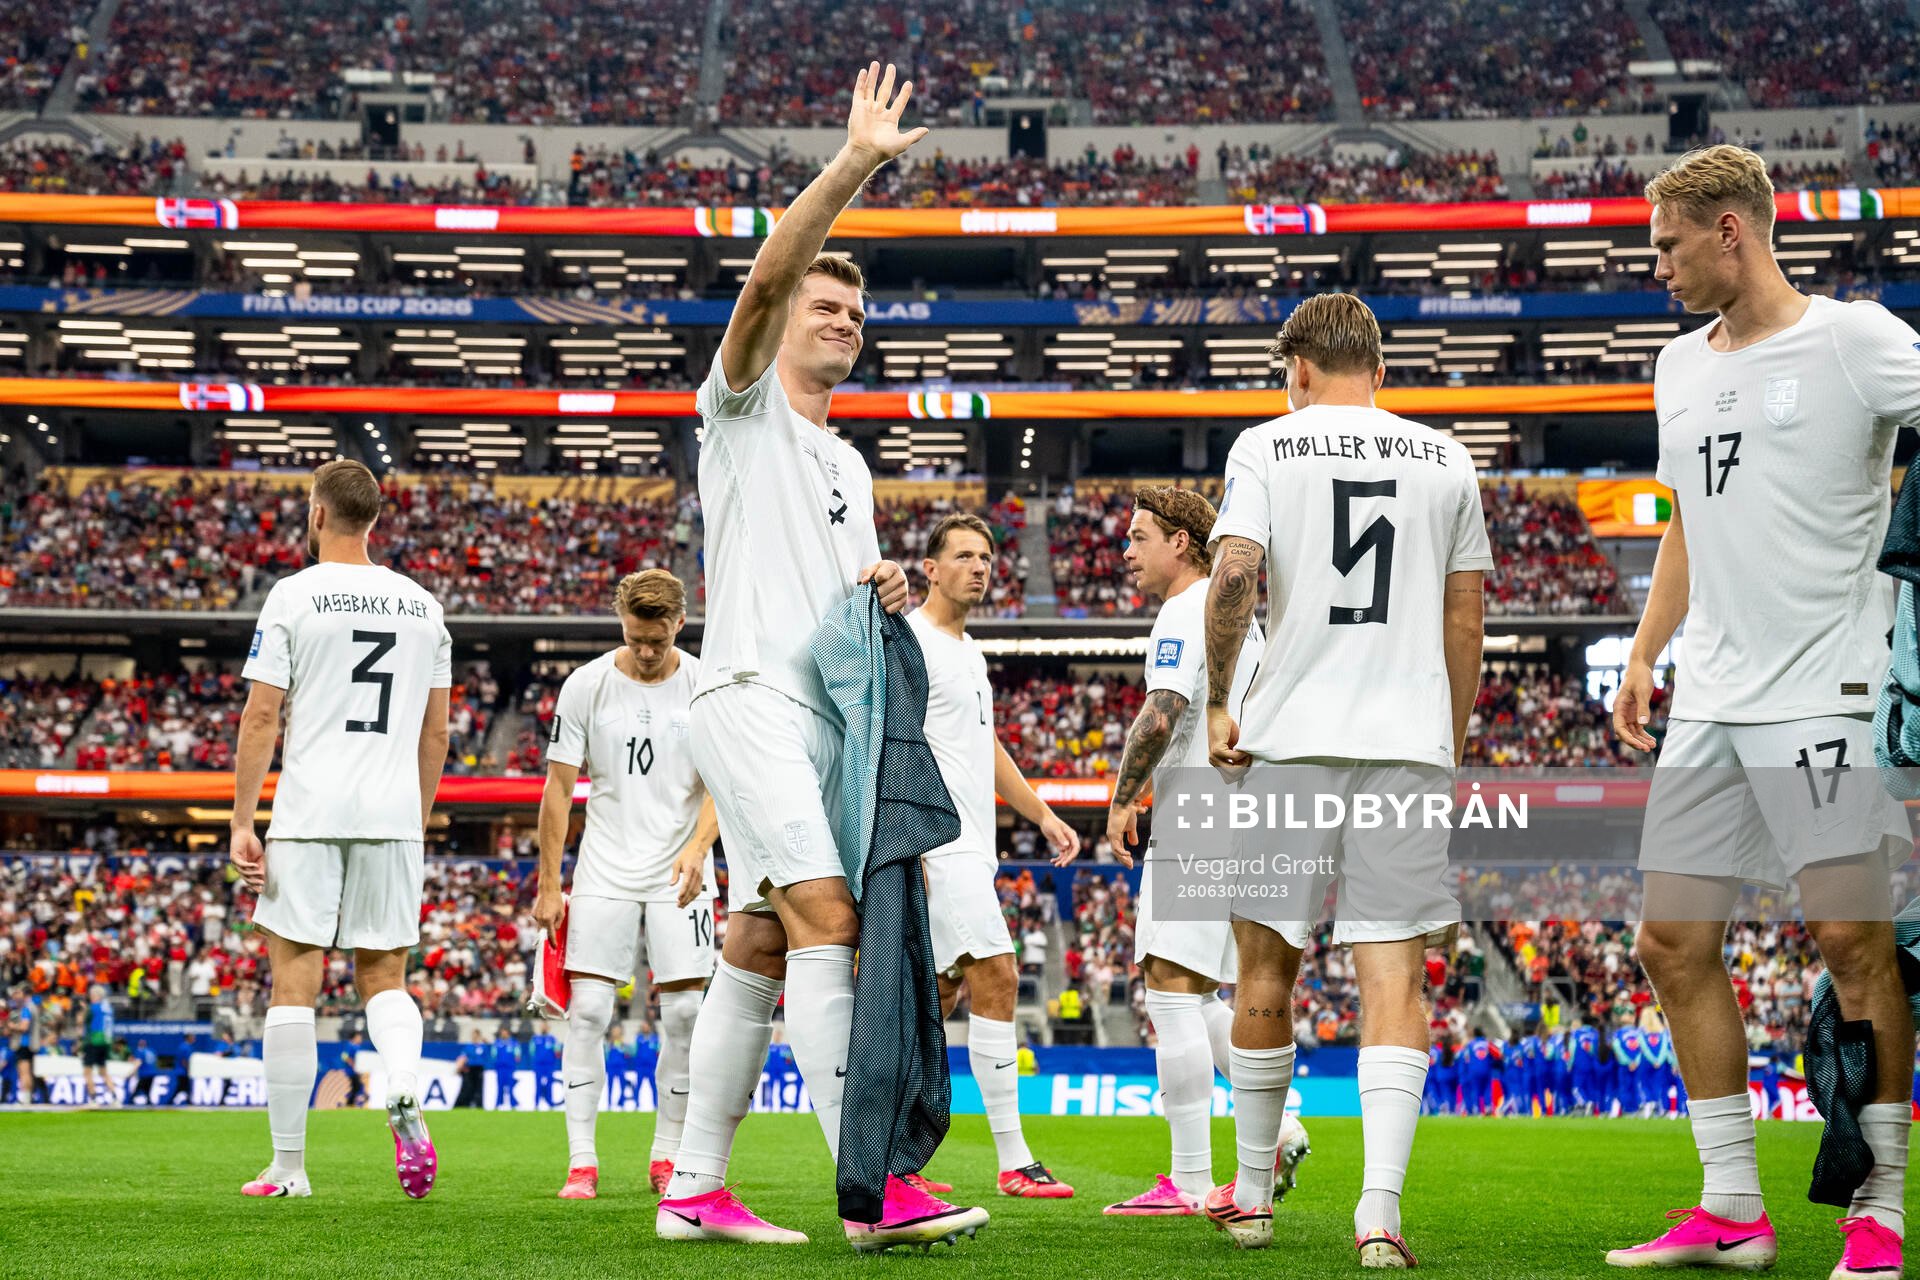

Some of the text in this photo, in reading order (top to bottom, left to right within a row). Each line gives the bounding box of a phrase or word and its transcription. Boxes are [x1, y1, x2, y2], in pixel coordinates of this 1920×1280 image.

[242, 295, 474, 316] FIFA WORLD CUP 2026
[865, 302, 931, 320] LAS
[1273, 435, 1448, 467] MØLLER WOLFE
[1698, 431, 1742, 497] 17
[1321, 478, 1397, 625] 5
[311, 593, 392, 616] VASSBAKK
[345, 629, 397, 735] 3
[626, 737, 654, 776] 10
[1795, 738, 1852, 810] 17
[688, 908, 712, 947] 10
